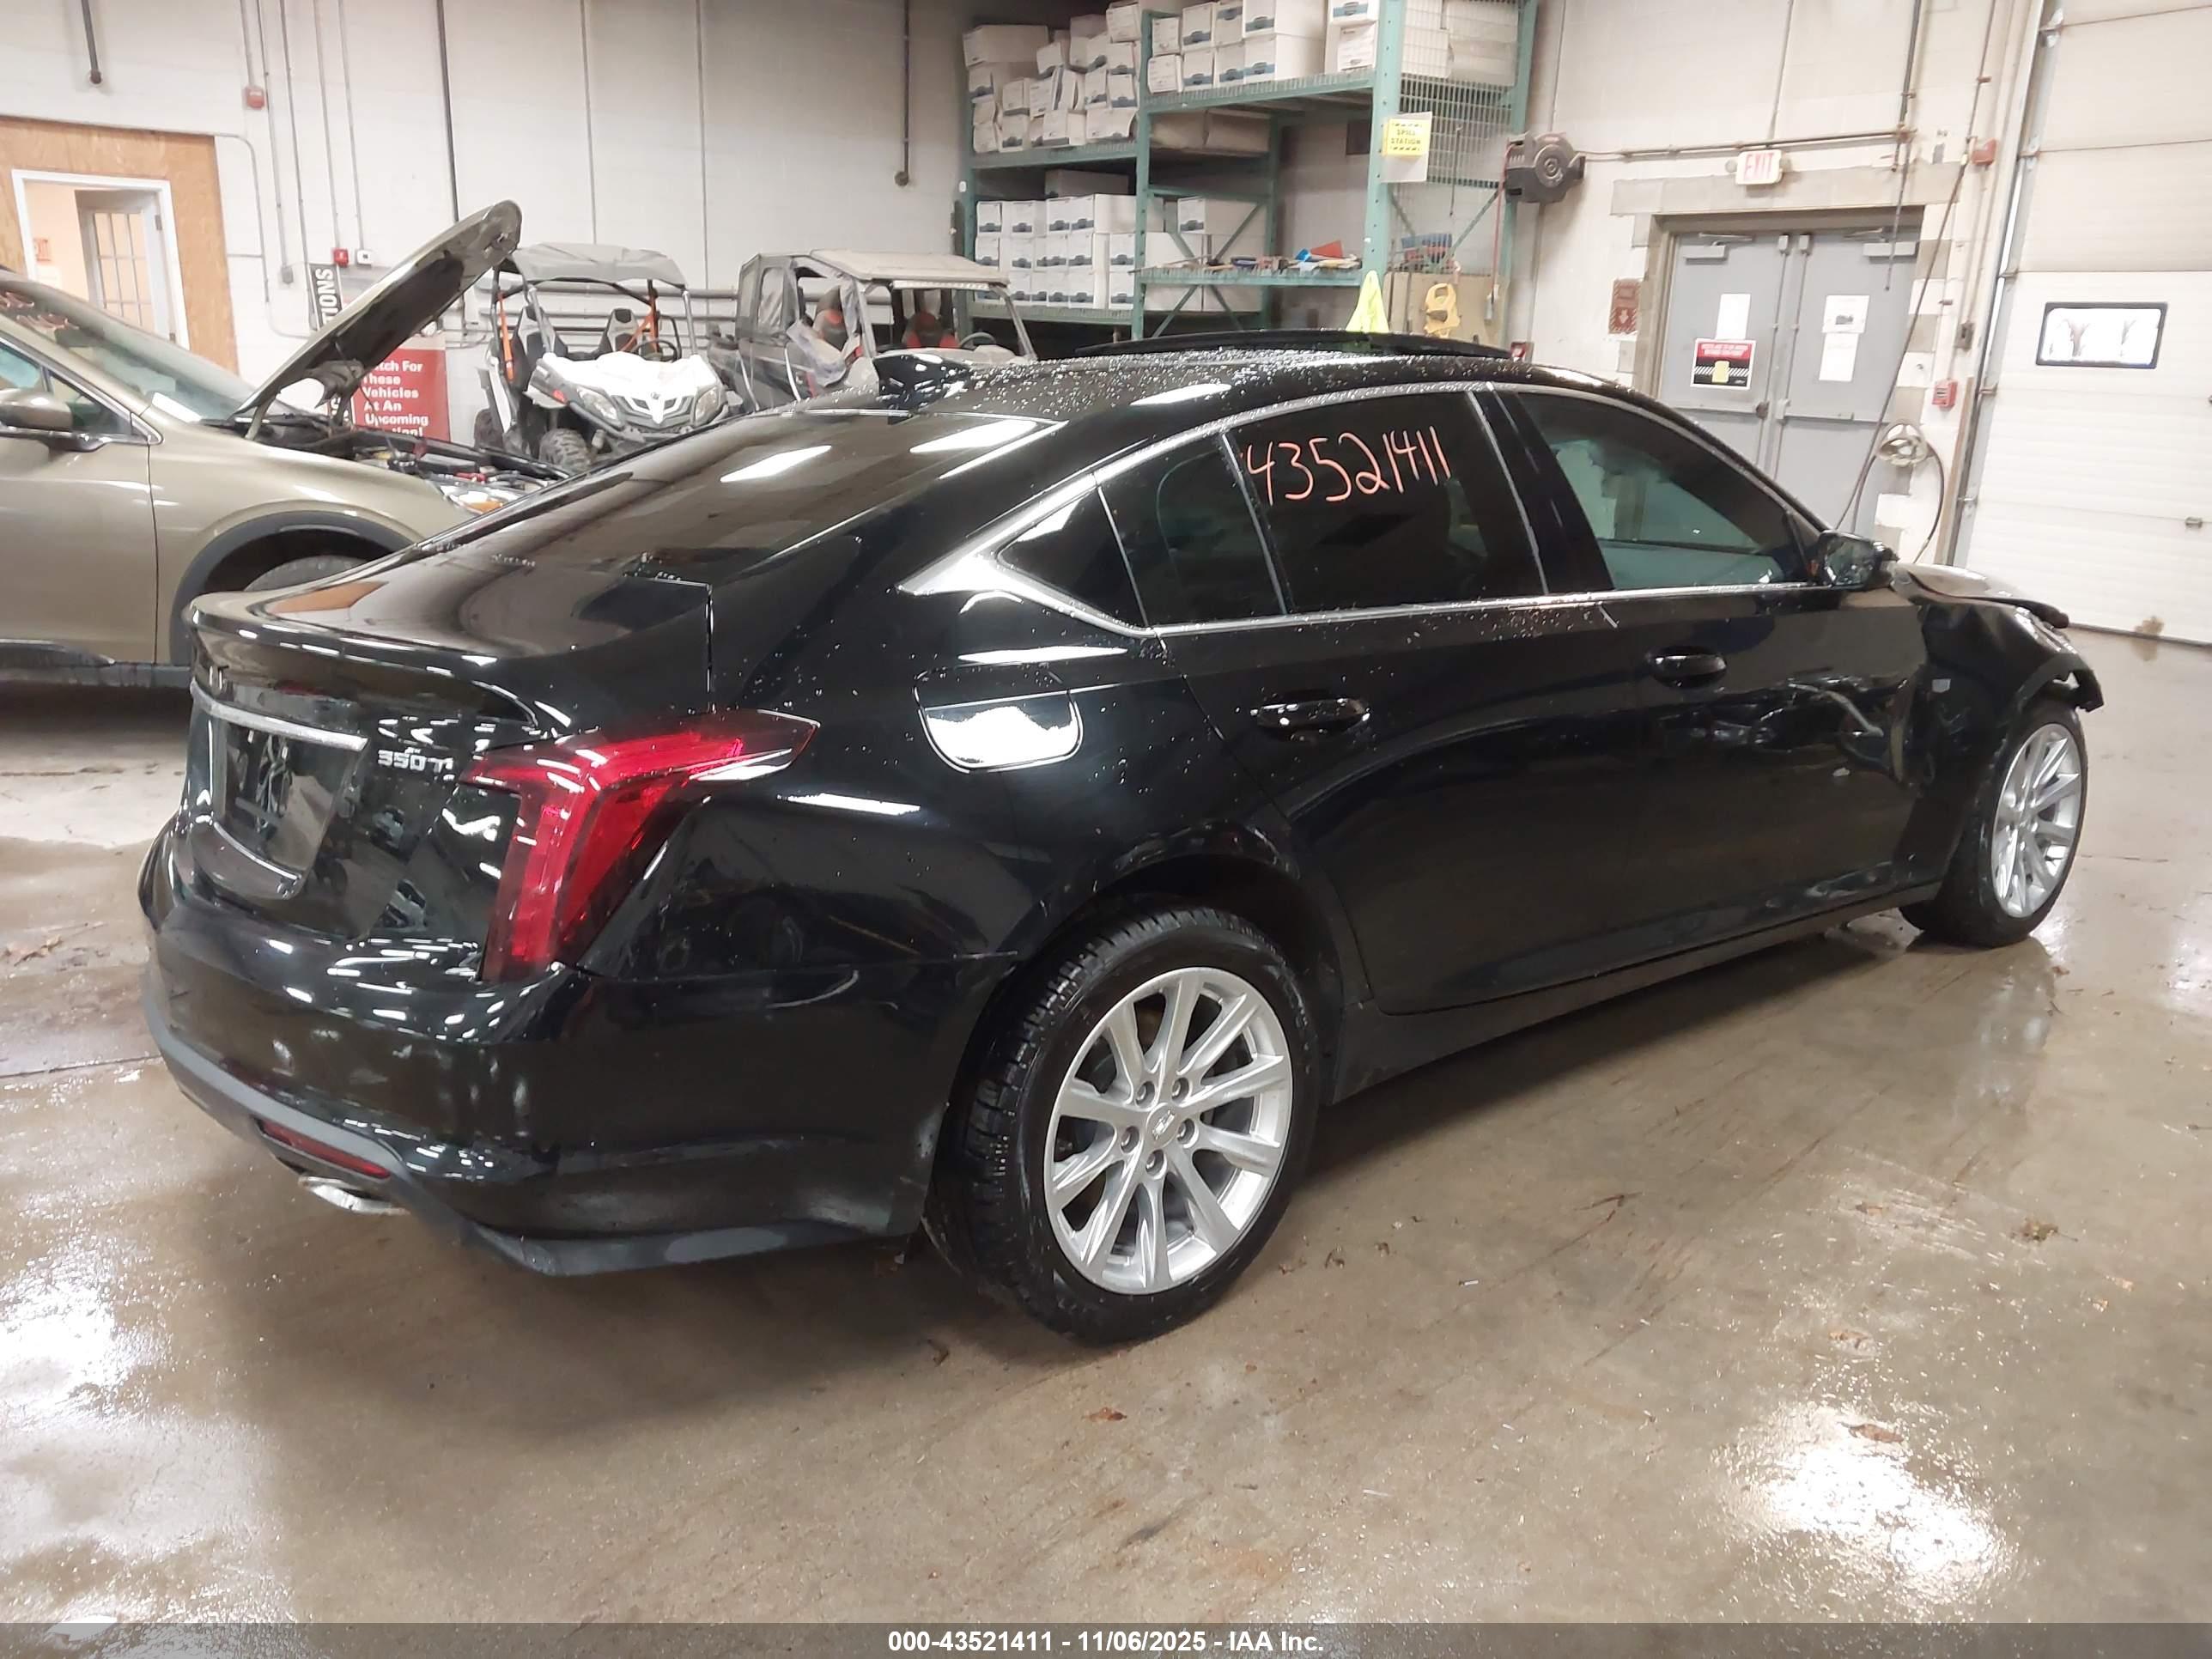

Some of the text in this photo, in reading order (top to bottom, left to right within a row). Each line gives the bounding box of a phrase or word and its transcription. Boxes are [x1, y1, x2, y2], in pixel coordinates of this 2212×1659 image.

[1744, 153, 1775, 181] EXIT
[315, 268, 337, 325] TIONS
[374, 360, 423, 372] tch For
[362, 386, 420, 398] Vehicles
[364, 400, 402, 411] At An
[365, 413, 429, 427] Upcoming
[1247, 426, 1452, 507] 43521411
